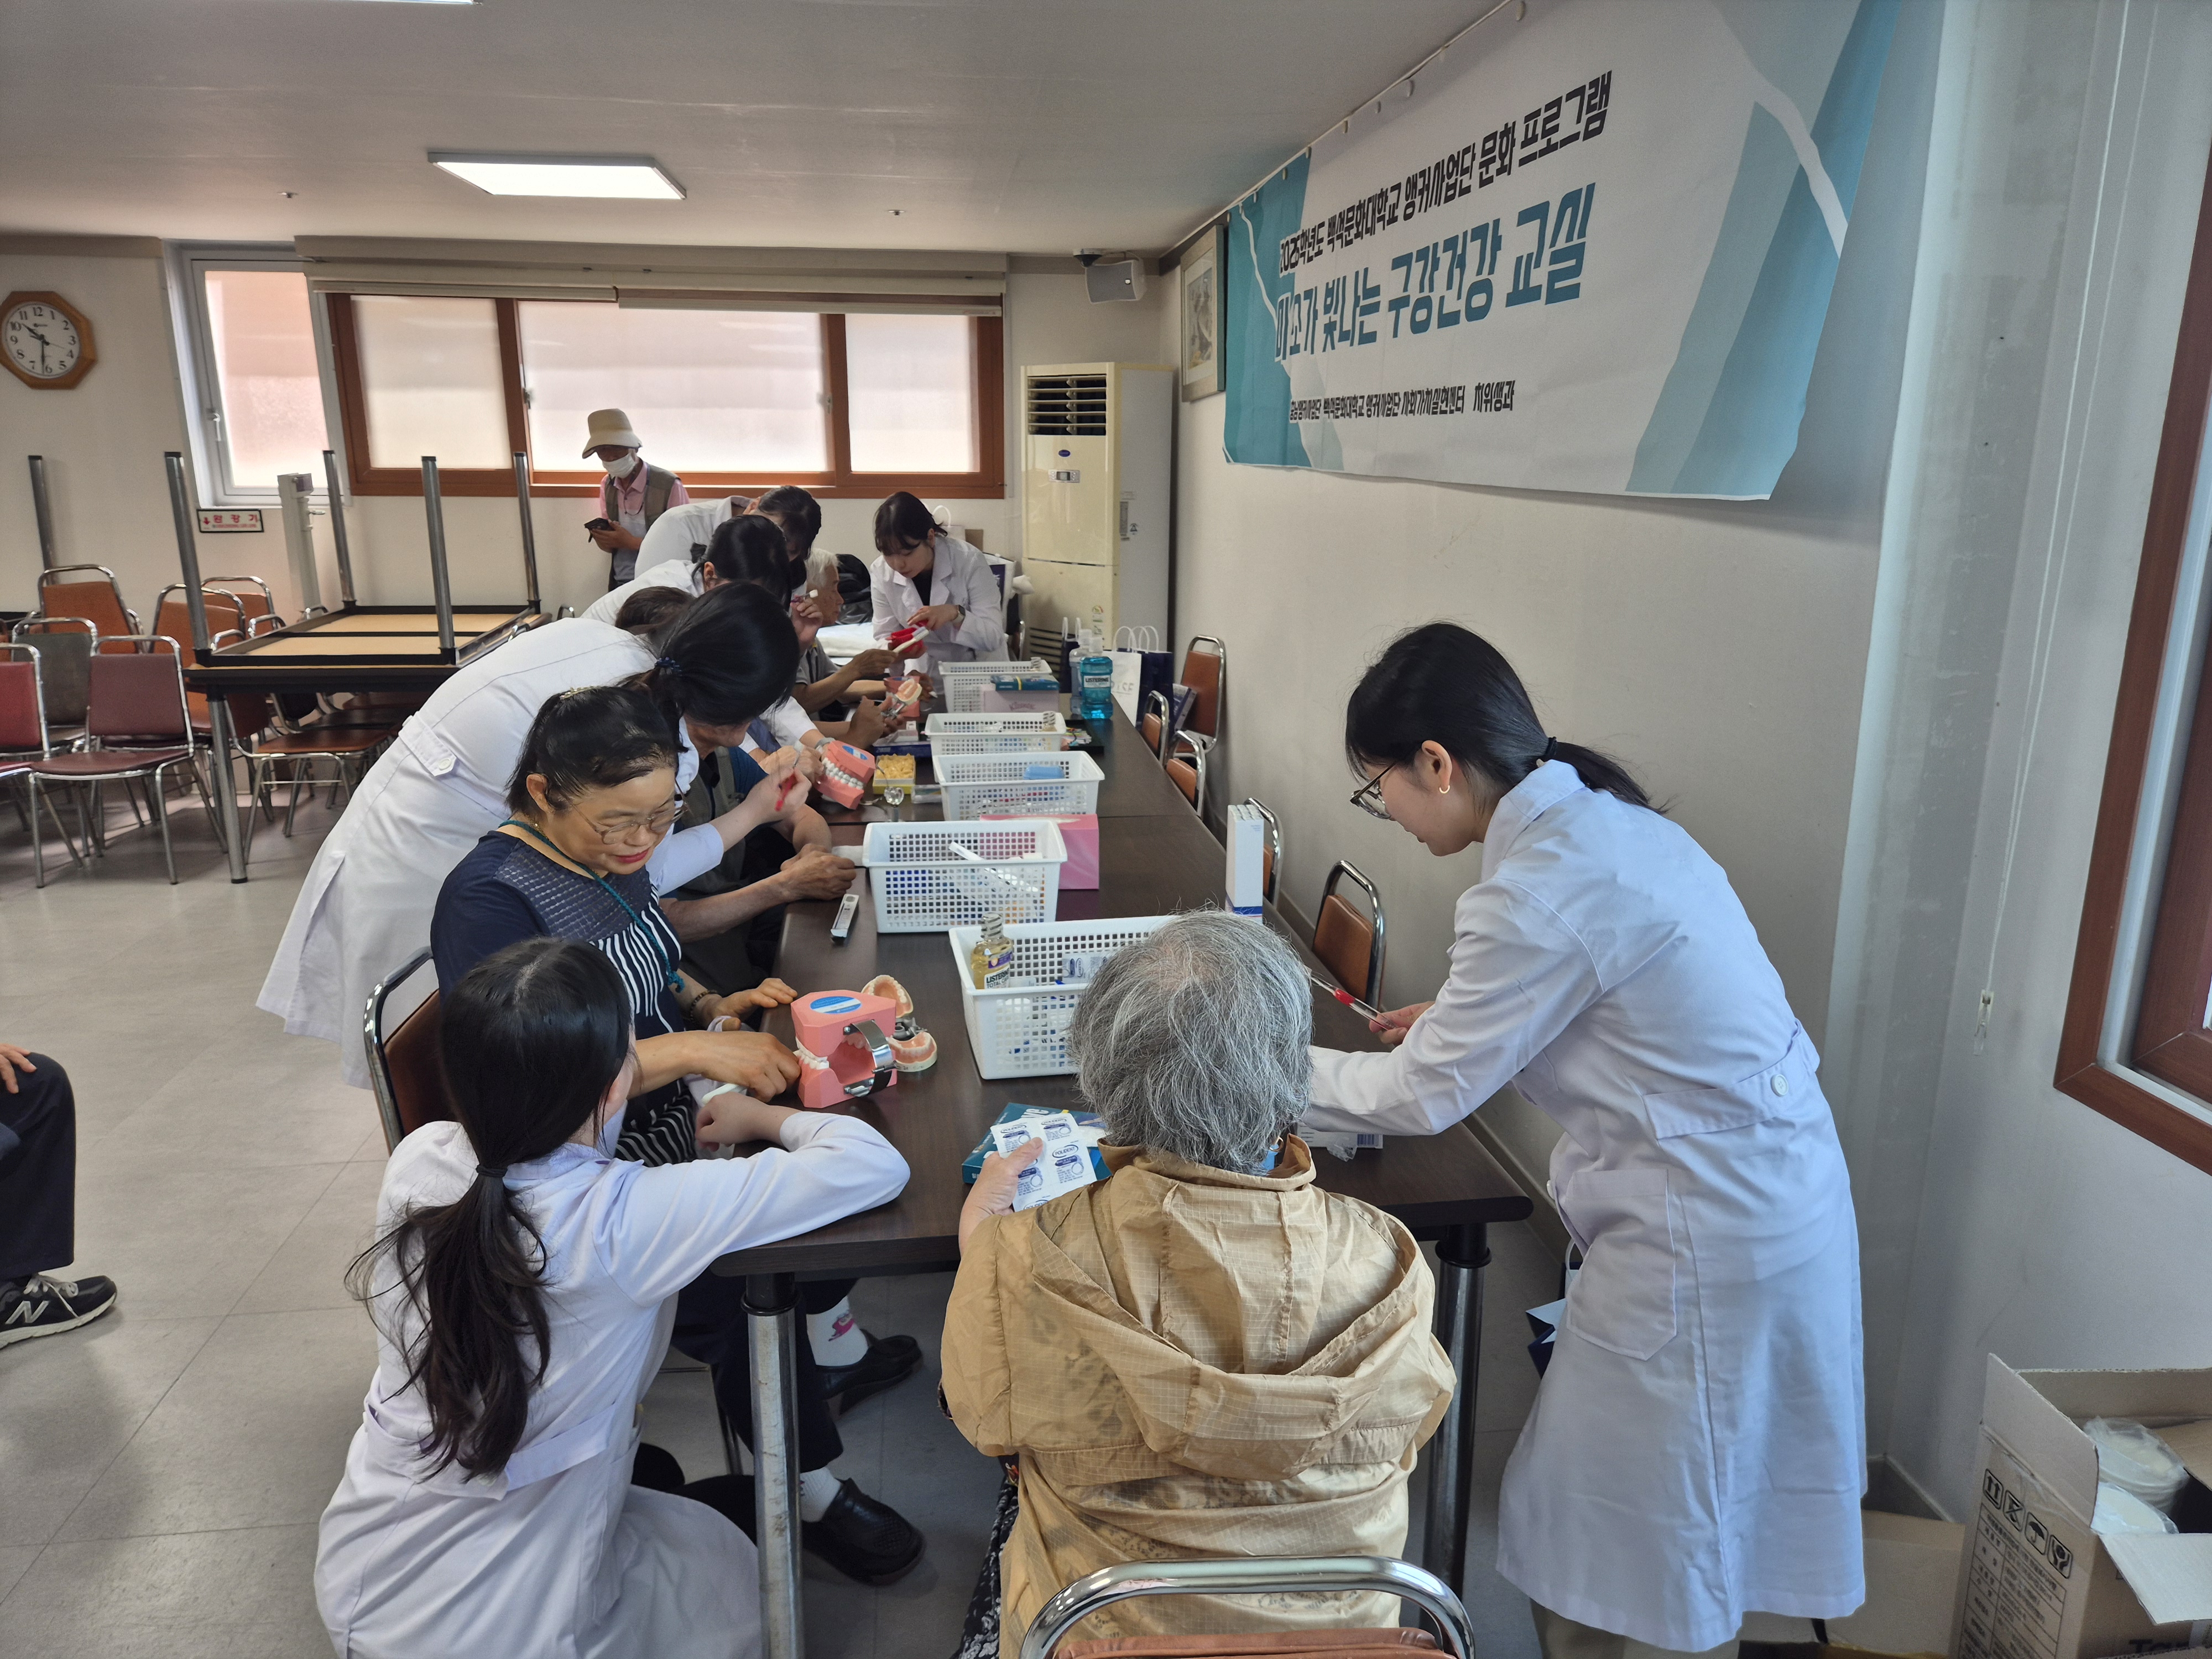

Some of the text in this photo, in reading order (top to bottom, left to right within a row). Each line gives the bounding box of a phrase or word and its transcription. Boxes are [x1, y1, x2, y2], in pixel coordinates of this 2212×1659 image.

[1327, 182, 1402, 253] 백석문화대학교
[1404, 142, 1476, 221] 앵커사업단
[1478, 121, 1517, 189] 문화
[1518, 70, 1613, 168] 프로그램
[1275, 182, 1596, 361] 미소가 빛나는 구강건강 교실
[33, 306, 43, 316] 12
[62, 320, 70, 331] 2
[11, 335, 18, 345] 9
[68, 335, 76, 345] 3
[45, 364, 53, 374] 6
[1323, 394, 1365, 419] 백석문화대학교
[1366, 392, 1401, 418] 앵커사업단
[1401, 385, 1466, 416] 사회가치실현센터
[1473, 380, 1516, 413] 치위생과
[1055, 1146, 1075, 1156] POLIDENT
